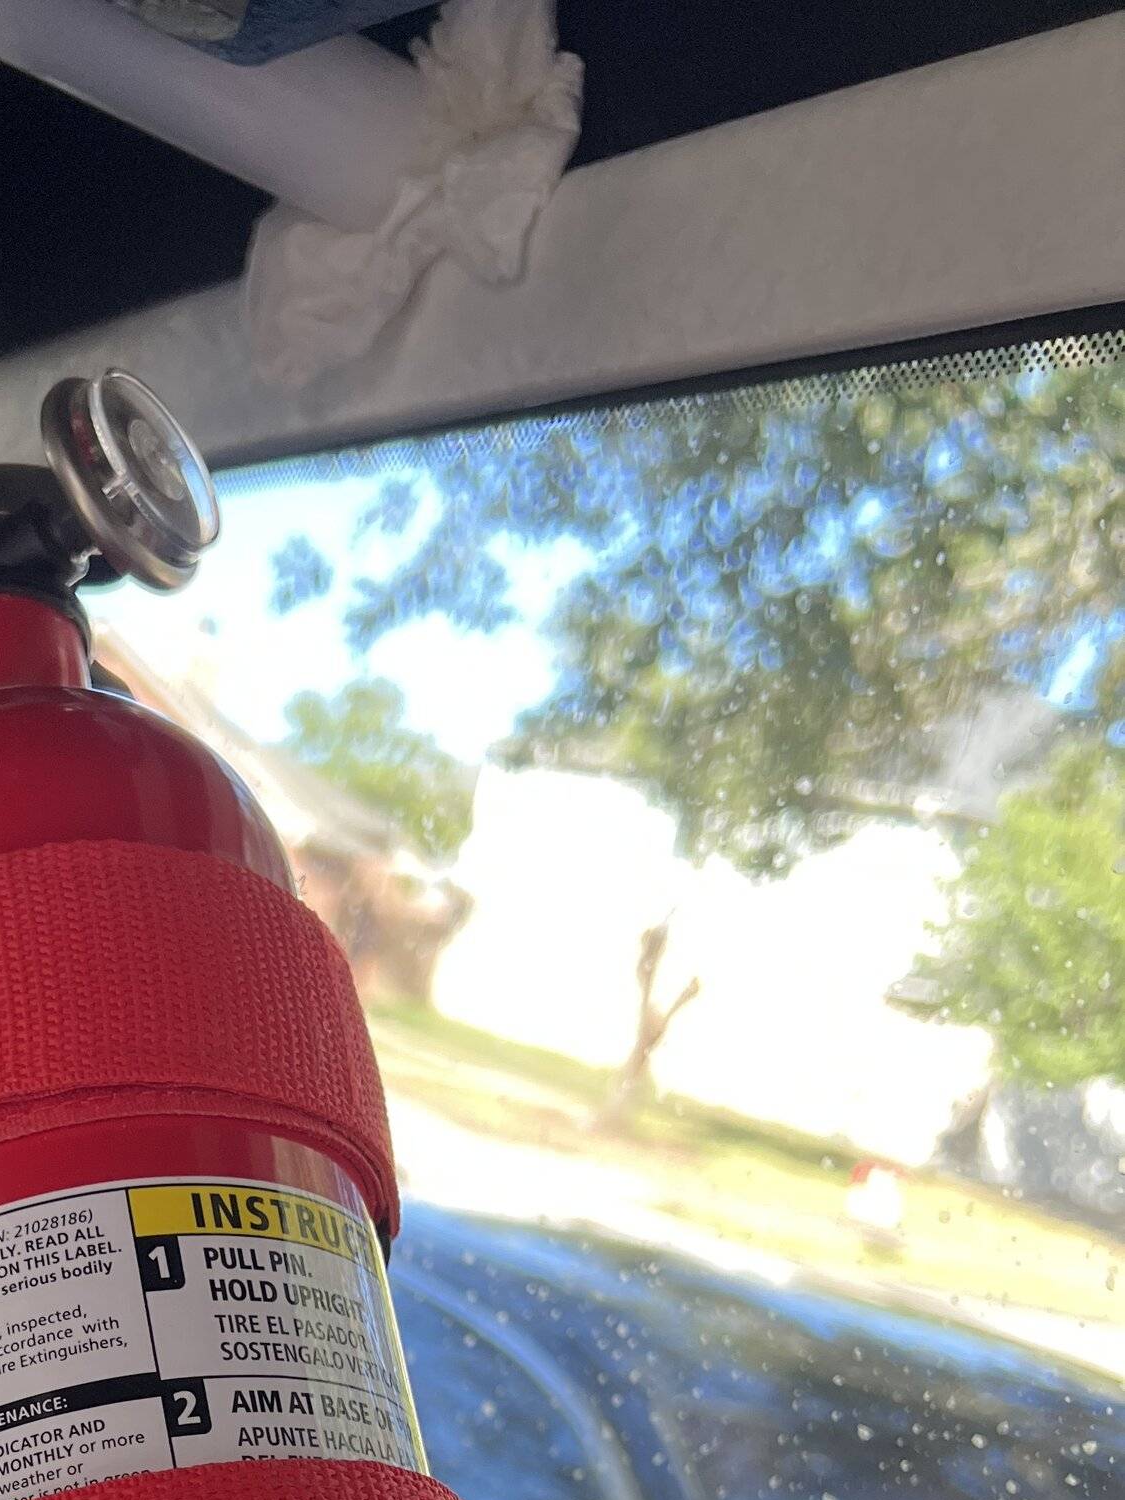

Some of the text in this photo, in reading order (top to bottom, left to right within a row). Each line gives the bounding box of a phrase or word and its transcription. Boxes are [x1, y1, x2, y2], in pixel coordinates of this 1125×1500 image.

[14, 1208, 94, 1238] 21028186)
[26, 1231, 69, 1253] READ
[75, 1225, 105, 1242] ALL
[25, 1251, 60, 1271] THIS
[65, 1241, 122, 1261] LABEL.
[149, 1246, 171, 1280] 1
[203, 1246, 313, 1278] PULL PIN.
[2, 1272, 58, 1296] serious
[61, 1259, 113, 1280] bodily
[209, 1279, 277, 1302] HOLD
[7, 1304, 88, 1335] inspected,
[82, 1316, 120, 1335] with
[215, 1314, 261, 1334] TIRE
[267, 1316, 289, 1336] EL
[20, 1336, 128, 1368] Extinguishers,
[220, 1342, 344, 1370] SOSTENGALO
[177, 1390, 201, 1425] 2
[232, 1389, 283, 1414] AIM
[289, 1391, 315, 1415] AT
[321, 1394, 372, 1425] BASE
[69, 1419, 105, 1438] AND
[79, 1442, 96, 1454] or
[102, 1433, 146, 1450] more
[238, 1427, 320, 1448] APUNTE
[324, 1430, 376, 1457] HACIA
[67, 1462, 84, 1476] or
